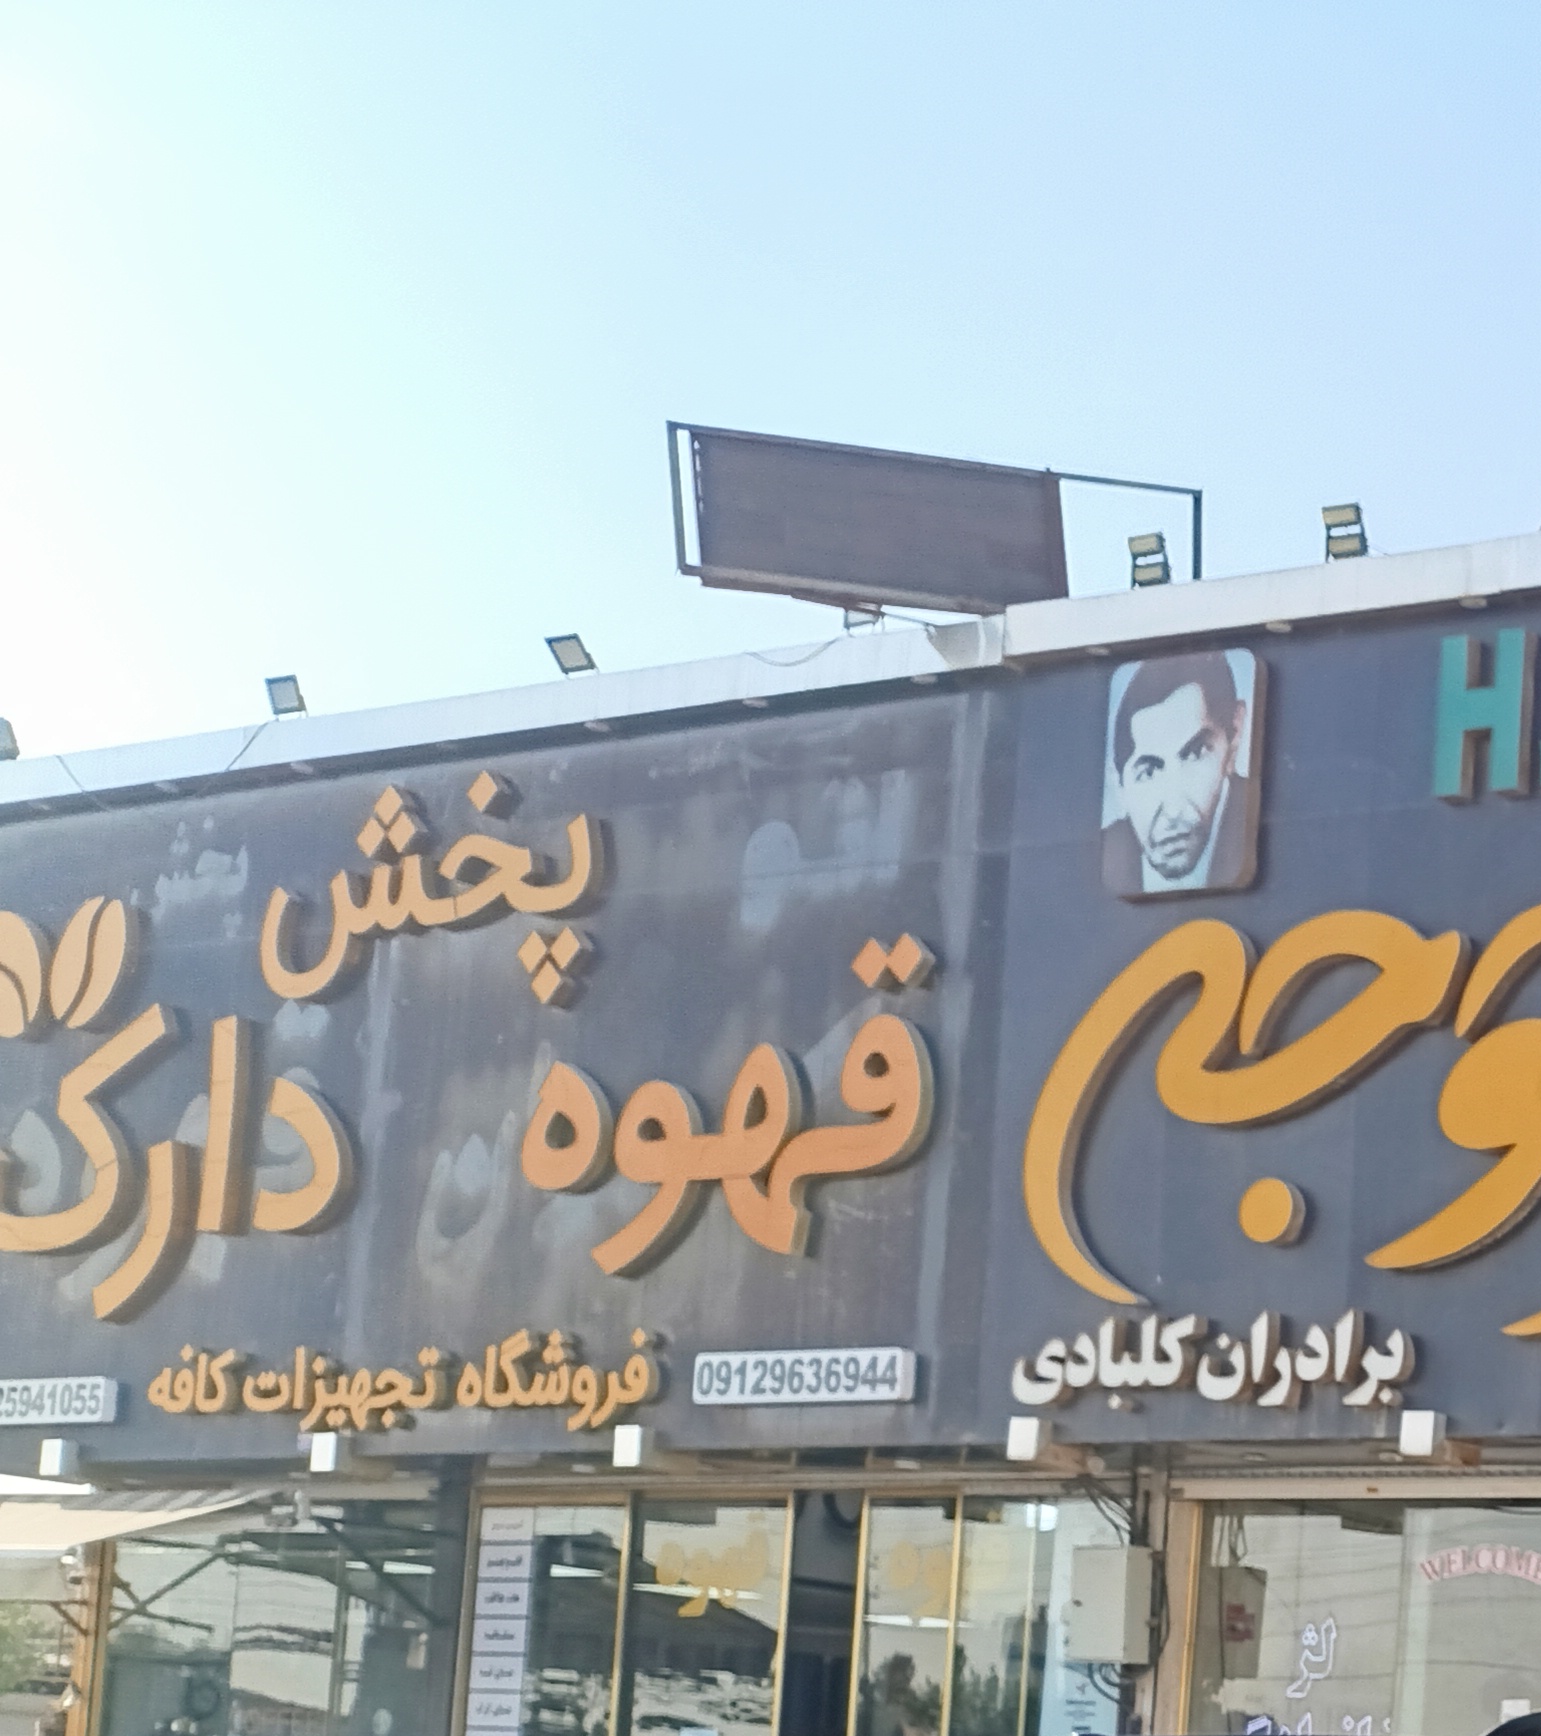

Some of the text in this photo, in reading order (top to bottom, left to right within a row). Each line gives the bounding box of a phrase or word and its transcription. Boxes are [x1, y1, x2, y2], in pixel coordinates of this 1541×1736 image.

[258, 770, 600, 1005] پخش
[0, 931, 936, 1322] قهوه دارک
[146, 1327, 653, 1432] فروشگاه تجهیزات کافه
[697, 1355, 899, 1396] 09129636944
[1011, 1308, 1407, 1410] برادران کلبادی
